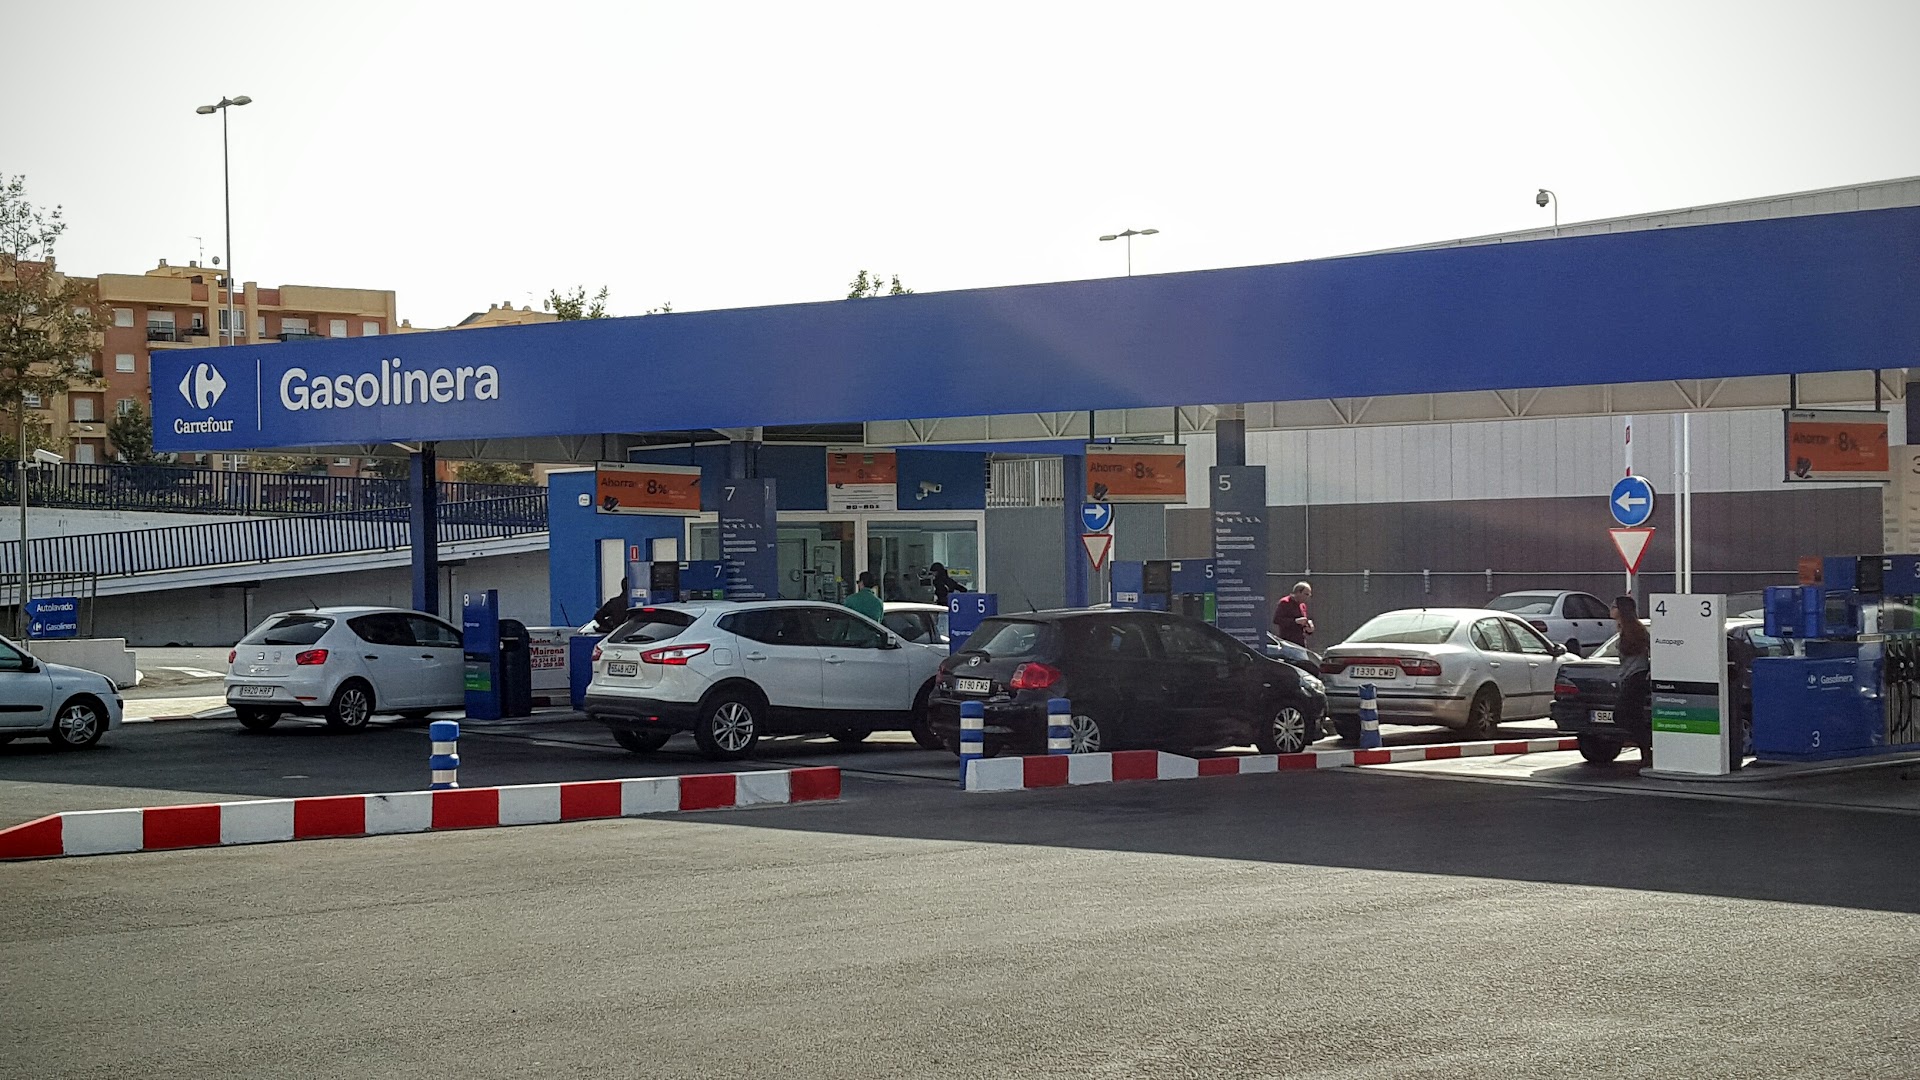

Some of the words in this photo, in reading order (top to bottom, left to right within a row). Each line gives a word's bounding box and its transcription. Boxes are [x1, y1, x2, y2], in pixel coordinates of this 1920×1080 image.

[280, 358, 499, 411] Gasolinera
[174, 418, 234, 434] Carrefour
[1090, 462, 1123, 473] Ahorra
[601, 477, 635, 488] Ahorra
[646, 479, 668, 495] 8%
[1218, 475, 1232, 491] 5
[724, 486, 736, 501] 7
[713, 565, 722, 578] 7
[1205, 564, 1214, 578] 5
[36, 602, 74, 613] Autolavado
[463, 594, 470, 607] 8
[480, 594, 487, 607] 7
[951, 598, 959, 613] 6
[977, 599, 986, 613] 5
[1655, 600, 1667, 616] 4
[1700, 600, 1712, 618] 3
[46, 621, 77, 632] Gasolinera
[1655, 638, 1684, 646] Autopago
[959, 680, 974, 690] 6190
[1820, 674, 1854, 684] Gasolinera
[1811, 730, 1820, 748] 3
